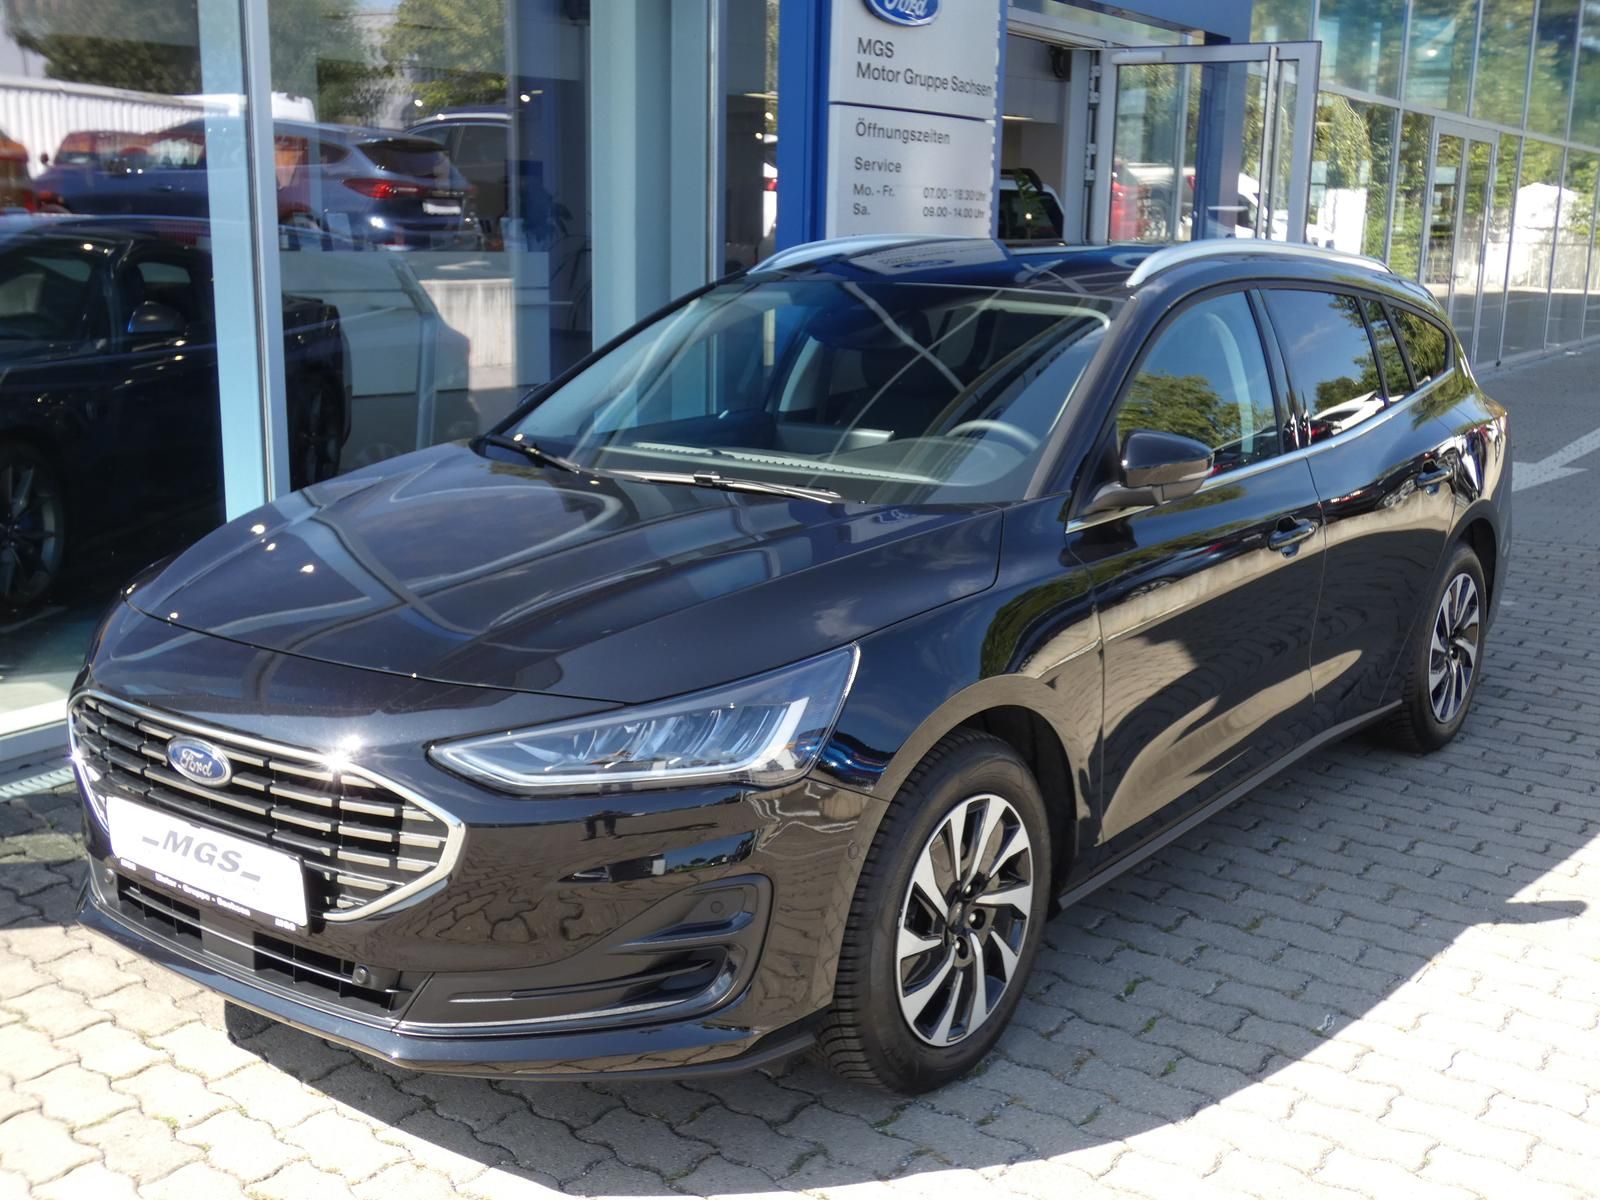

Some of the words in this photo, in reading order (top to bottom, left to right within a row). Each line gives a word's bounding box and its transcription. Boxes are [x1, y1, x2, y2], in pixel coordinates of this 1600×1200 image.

[857, 37, 895, 59] MGS
[856, 61, 900, 84] Motor
[904, 68, 949, 92] Gruppe
[951, 76, 993, 98] Sachsen
[856, 117, 950, 145] Öffnungszeiten
[854, 157, 902, 173] Service
[853, 183, 875, 197] Mo.
[882, 185, 896, 197] Fr.
[853, 202, 871, 216] Sa.
[180, 749, 213, 778] Ford
